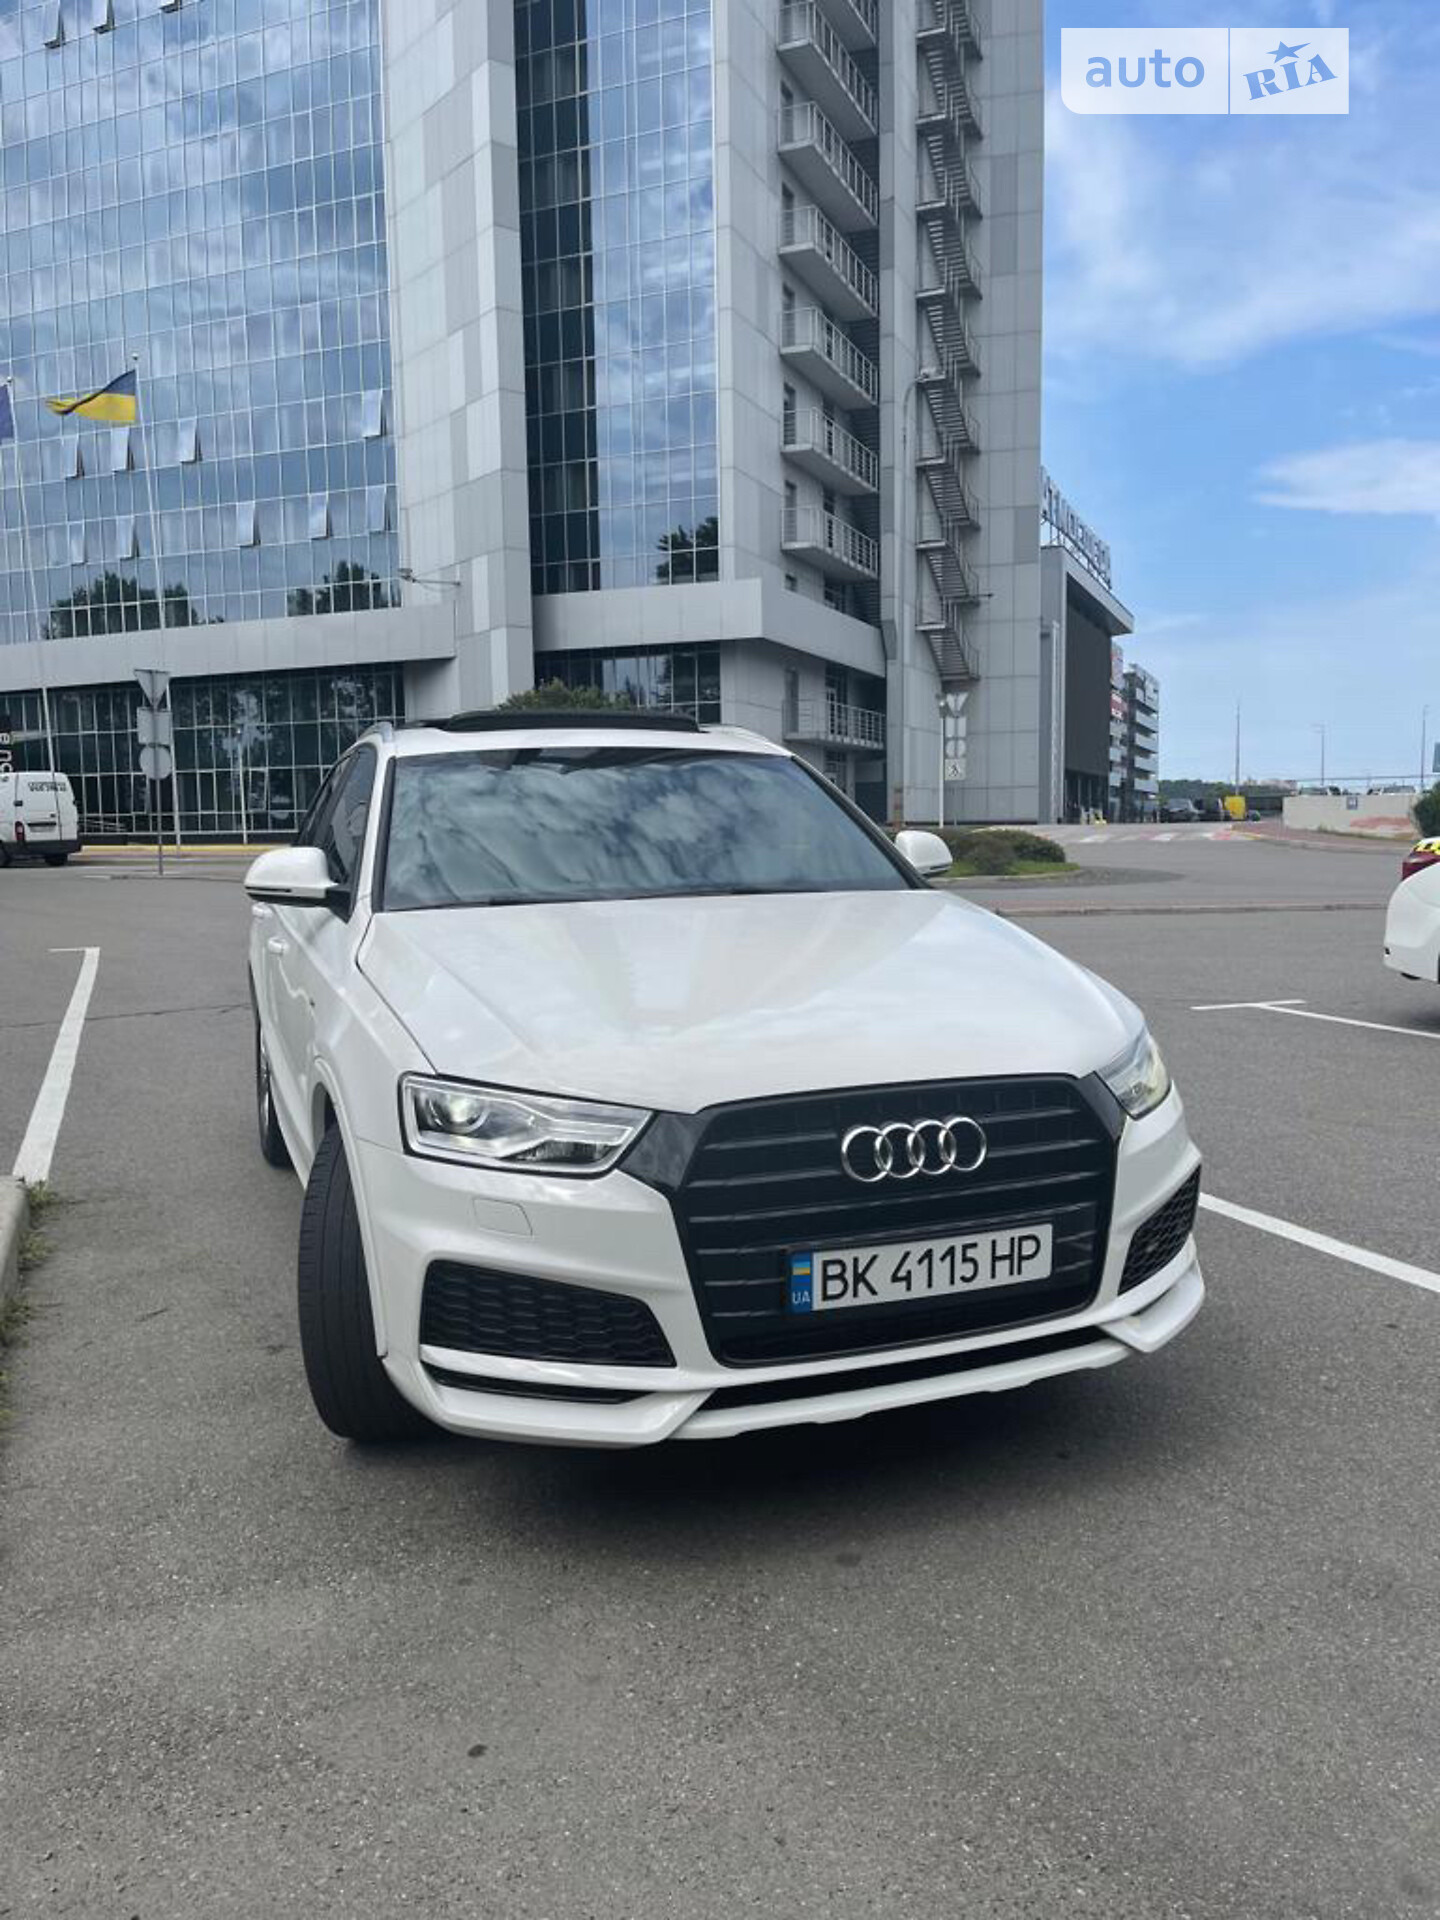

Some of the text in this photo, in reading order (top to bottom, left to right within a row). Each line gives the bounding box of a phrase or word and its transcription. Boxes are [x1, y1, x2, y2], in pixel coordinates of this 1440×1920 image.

[821, 1234, 1041, 1301] BK 4115 HP
[792, 1291, 811, 1304] UA
